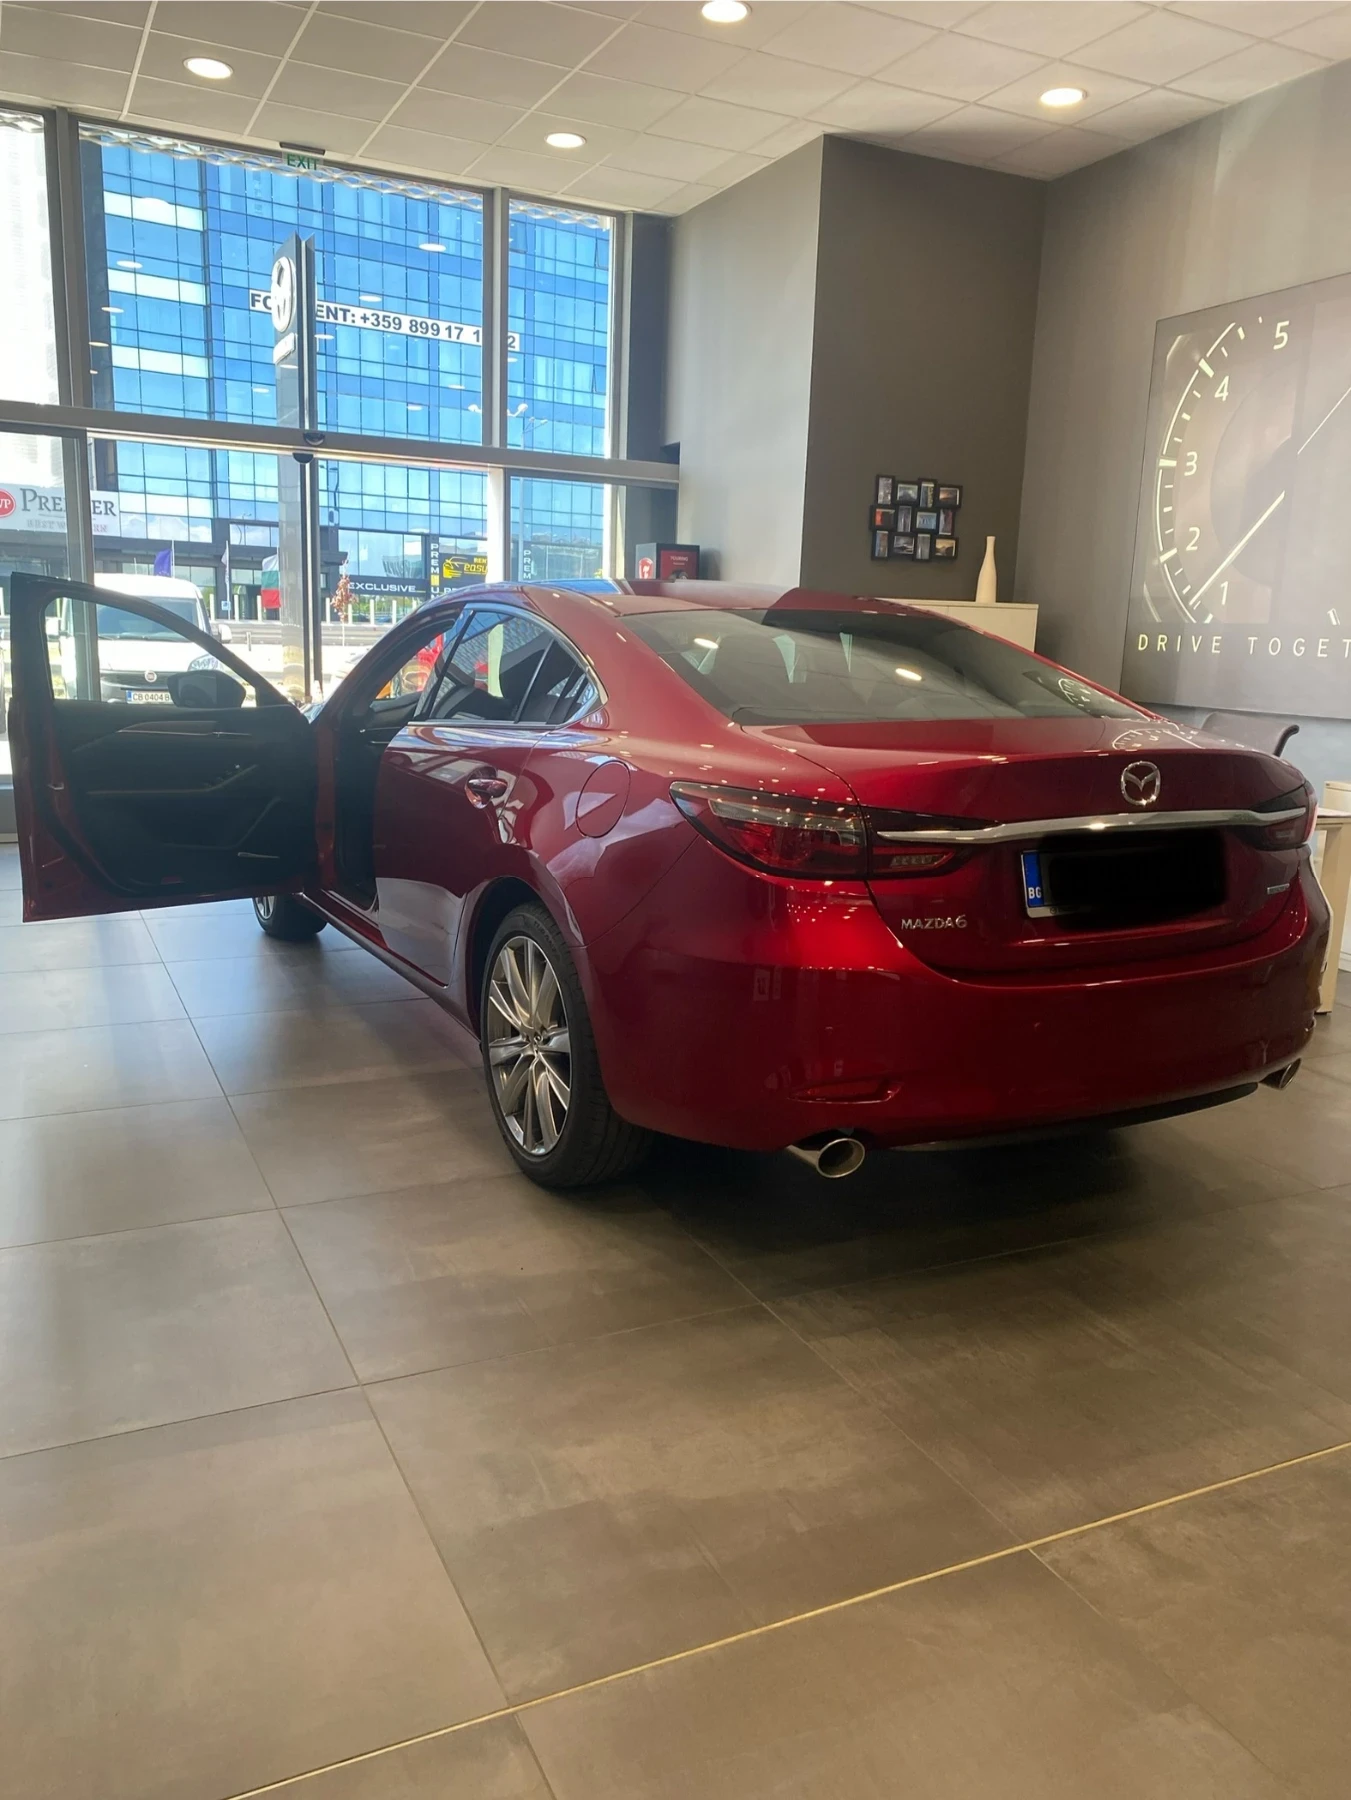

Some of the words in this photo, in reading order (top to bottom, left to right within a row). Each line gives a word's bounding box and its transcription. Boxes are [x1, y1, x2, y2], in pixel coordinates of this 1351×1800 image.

[287, 153, 320, 170] EXIT
[360, 312, 402, 331] +359
[409, 318, 441, 337] 899
[445, 324, 464, 341] 17
[1273, 320, 1290, 350] 5
[1214, 375, 1230, 402] 4
[1184, 451, 1199, 477] 3
[20, 488, 117, 517] PREER
[1185, 526, 1201, 552] 2
[348, 581, 417, 594] EXCLUSIVE
[1220, 581, 1229, 606] 1
[1138, 634, 1222, 654] DRIVE
[1247, 636, 1351, 659] TOGET
[1028, 886, 1042, 900] BG
